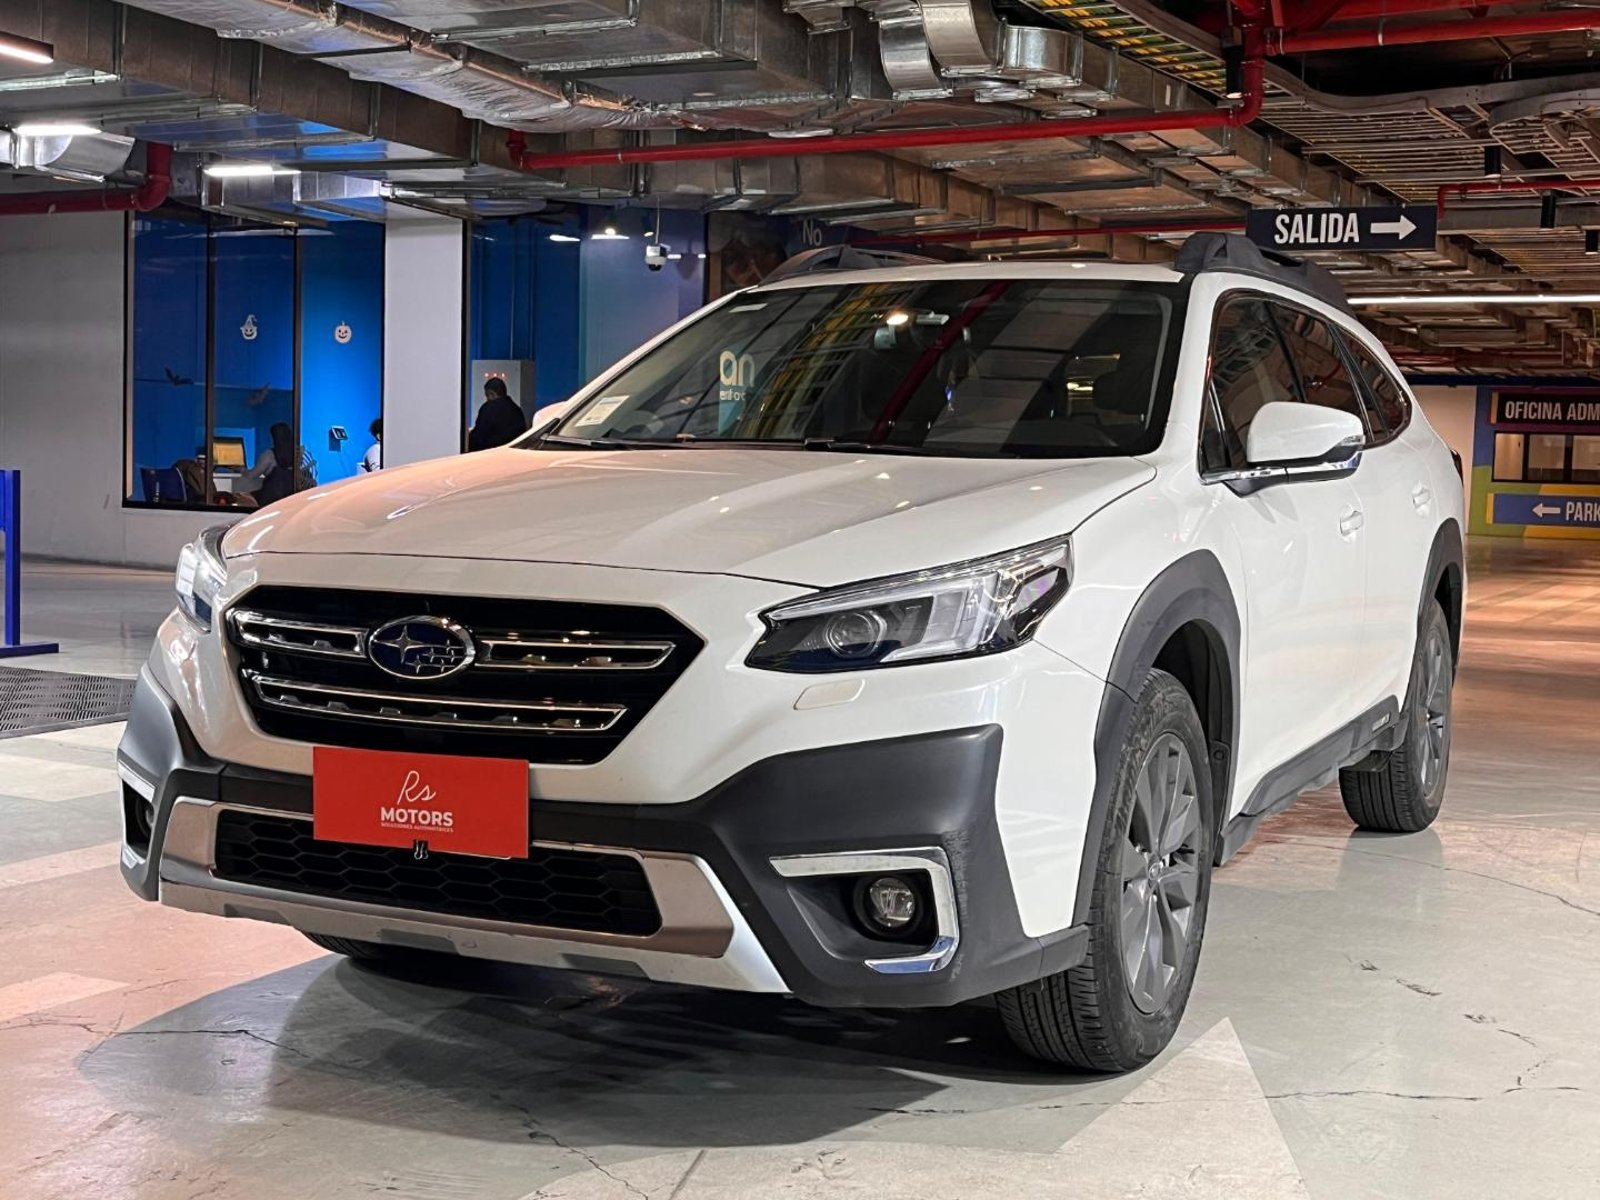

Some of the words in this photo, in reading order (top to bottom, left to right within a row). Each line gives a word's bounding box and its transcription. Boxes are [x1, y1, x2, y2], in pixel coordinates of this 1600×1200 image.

[802, 217, 822, 246] No
[1274, 213, 1360, 244] SALIDA
[1505, 401, 1562, 420] OFICINA
[1567, 403, 1600, 421] ADM
[1566, 501, 1600, 521] PARK
[397, 770, 437, 805] Rs
[381, 807, 454, 827] MOTORS
